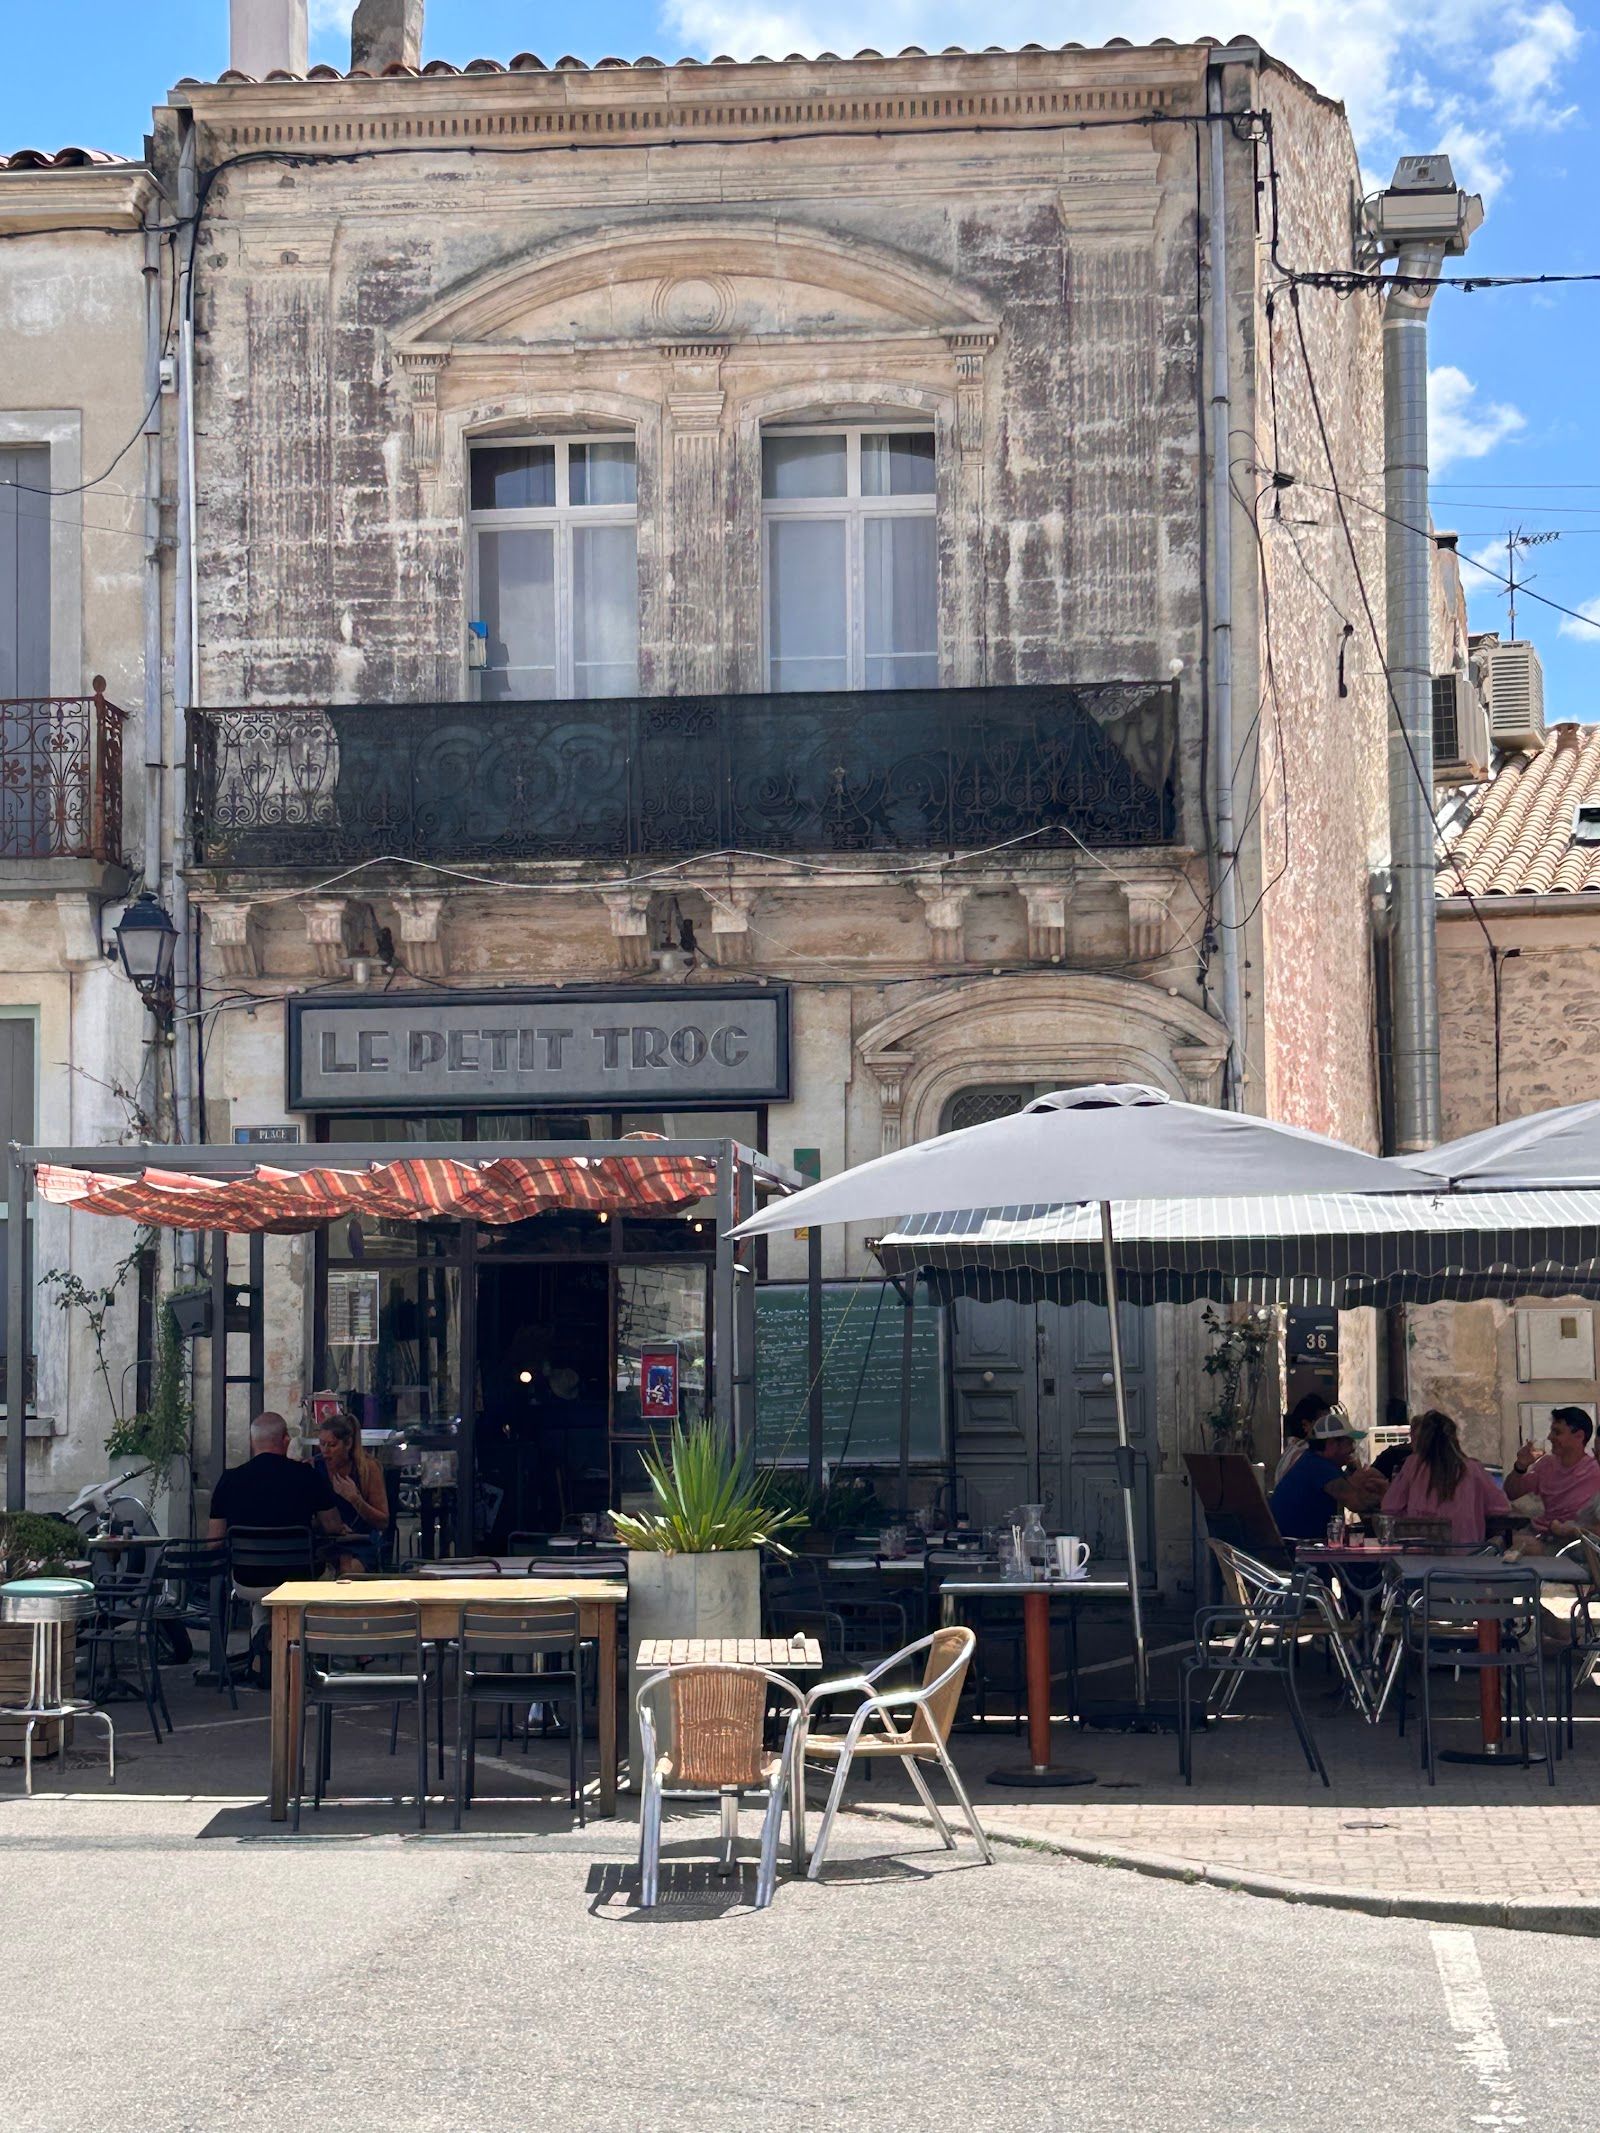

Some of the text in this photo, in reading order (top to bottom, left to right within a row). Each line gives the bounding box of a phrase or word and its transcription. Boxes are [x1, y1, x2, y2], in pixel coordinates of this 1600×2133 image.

[320, 1025, 749, 1074] LE PETIT TROC
[259, 1129, 286, 1140] PLACE
[1306, 1333, 1327, 1349] 36
